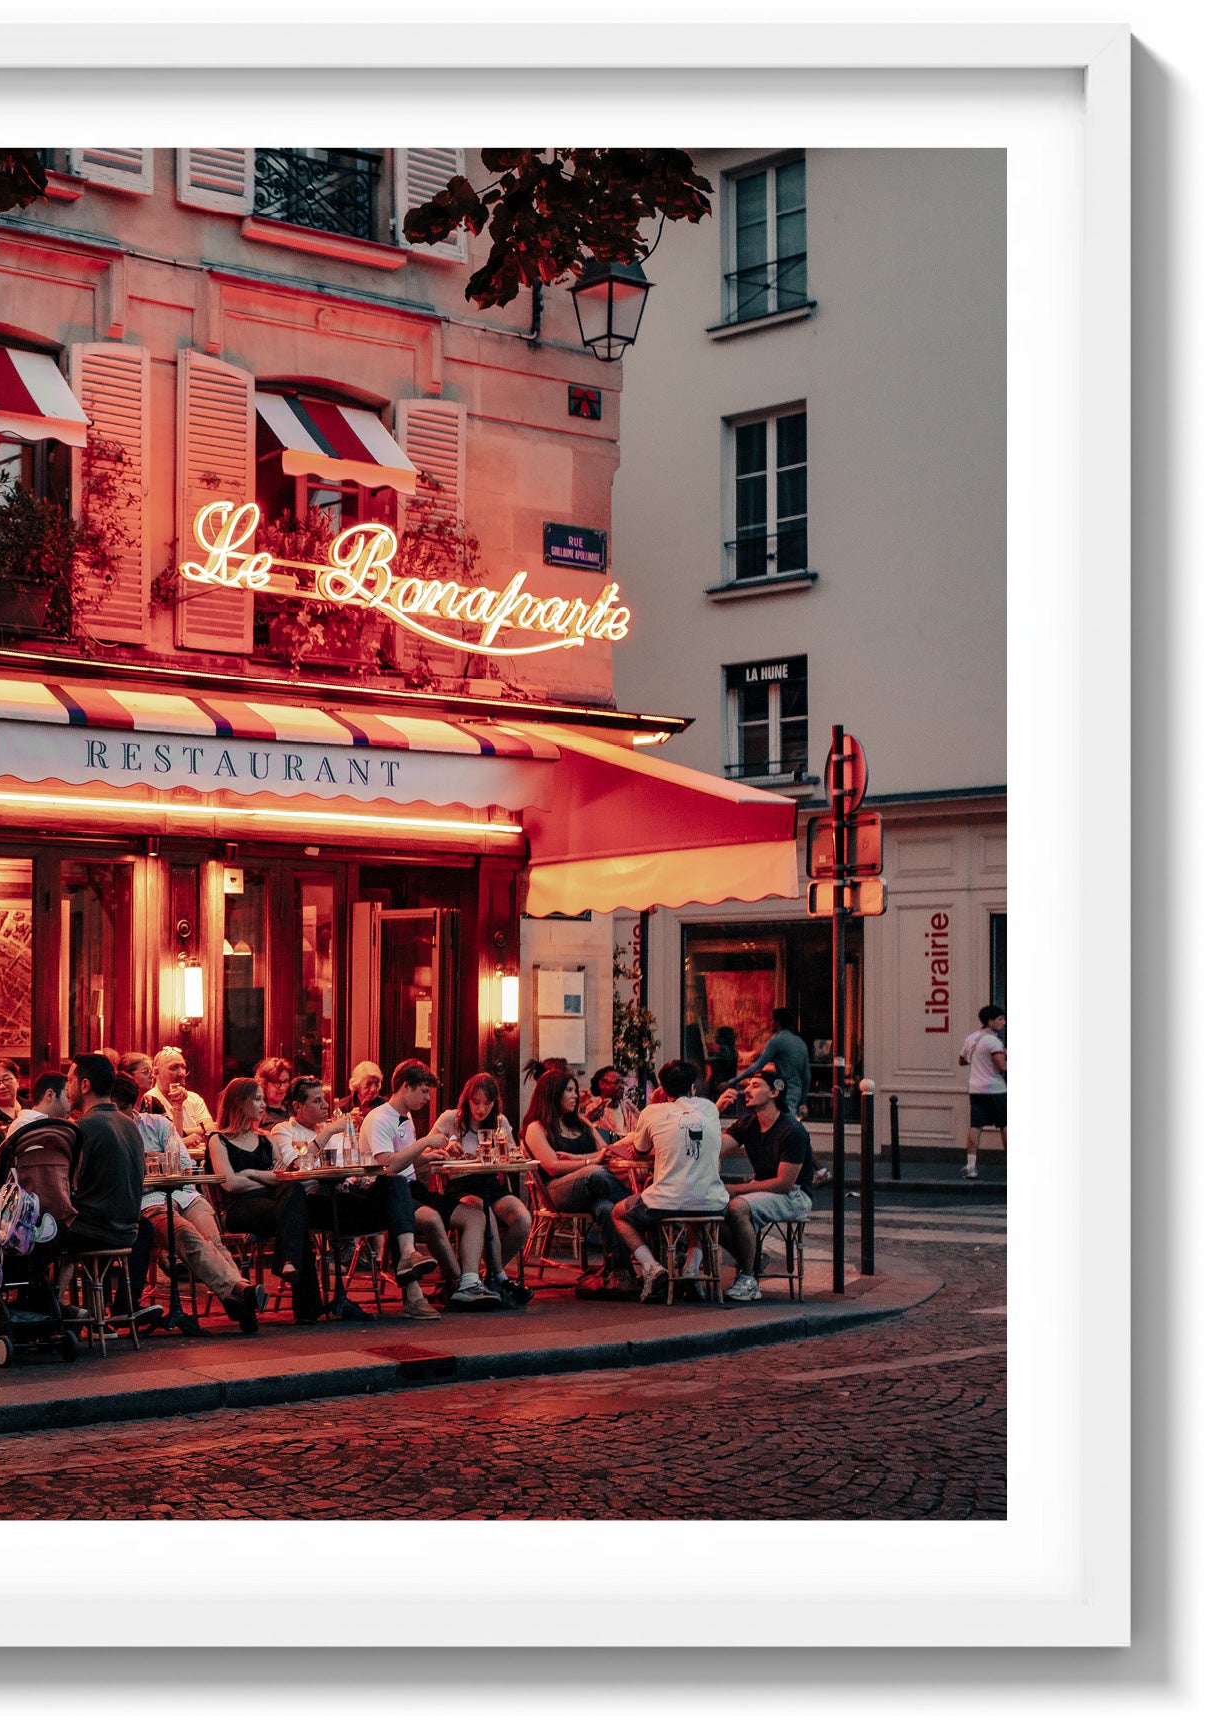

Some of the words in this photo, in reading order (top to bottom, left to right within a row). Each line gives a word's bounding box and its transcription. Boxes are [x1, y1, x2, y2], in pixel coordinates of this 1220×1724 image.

[568, 535, 584, 549] RUE
[180, 500, 273, 589] Le
[318, 522, 633, 656] Bonaparte
[746, 667, 759, 682] LA
[761, 663, 788, 680] HUNE
[84, 738, 401, 788] RESTAURANT
[925, 912, 949, 1034] Librairie
